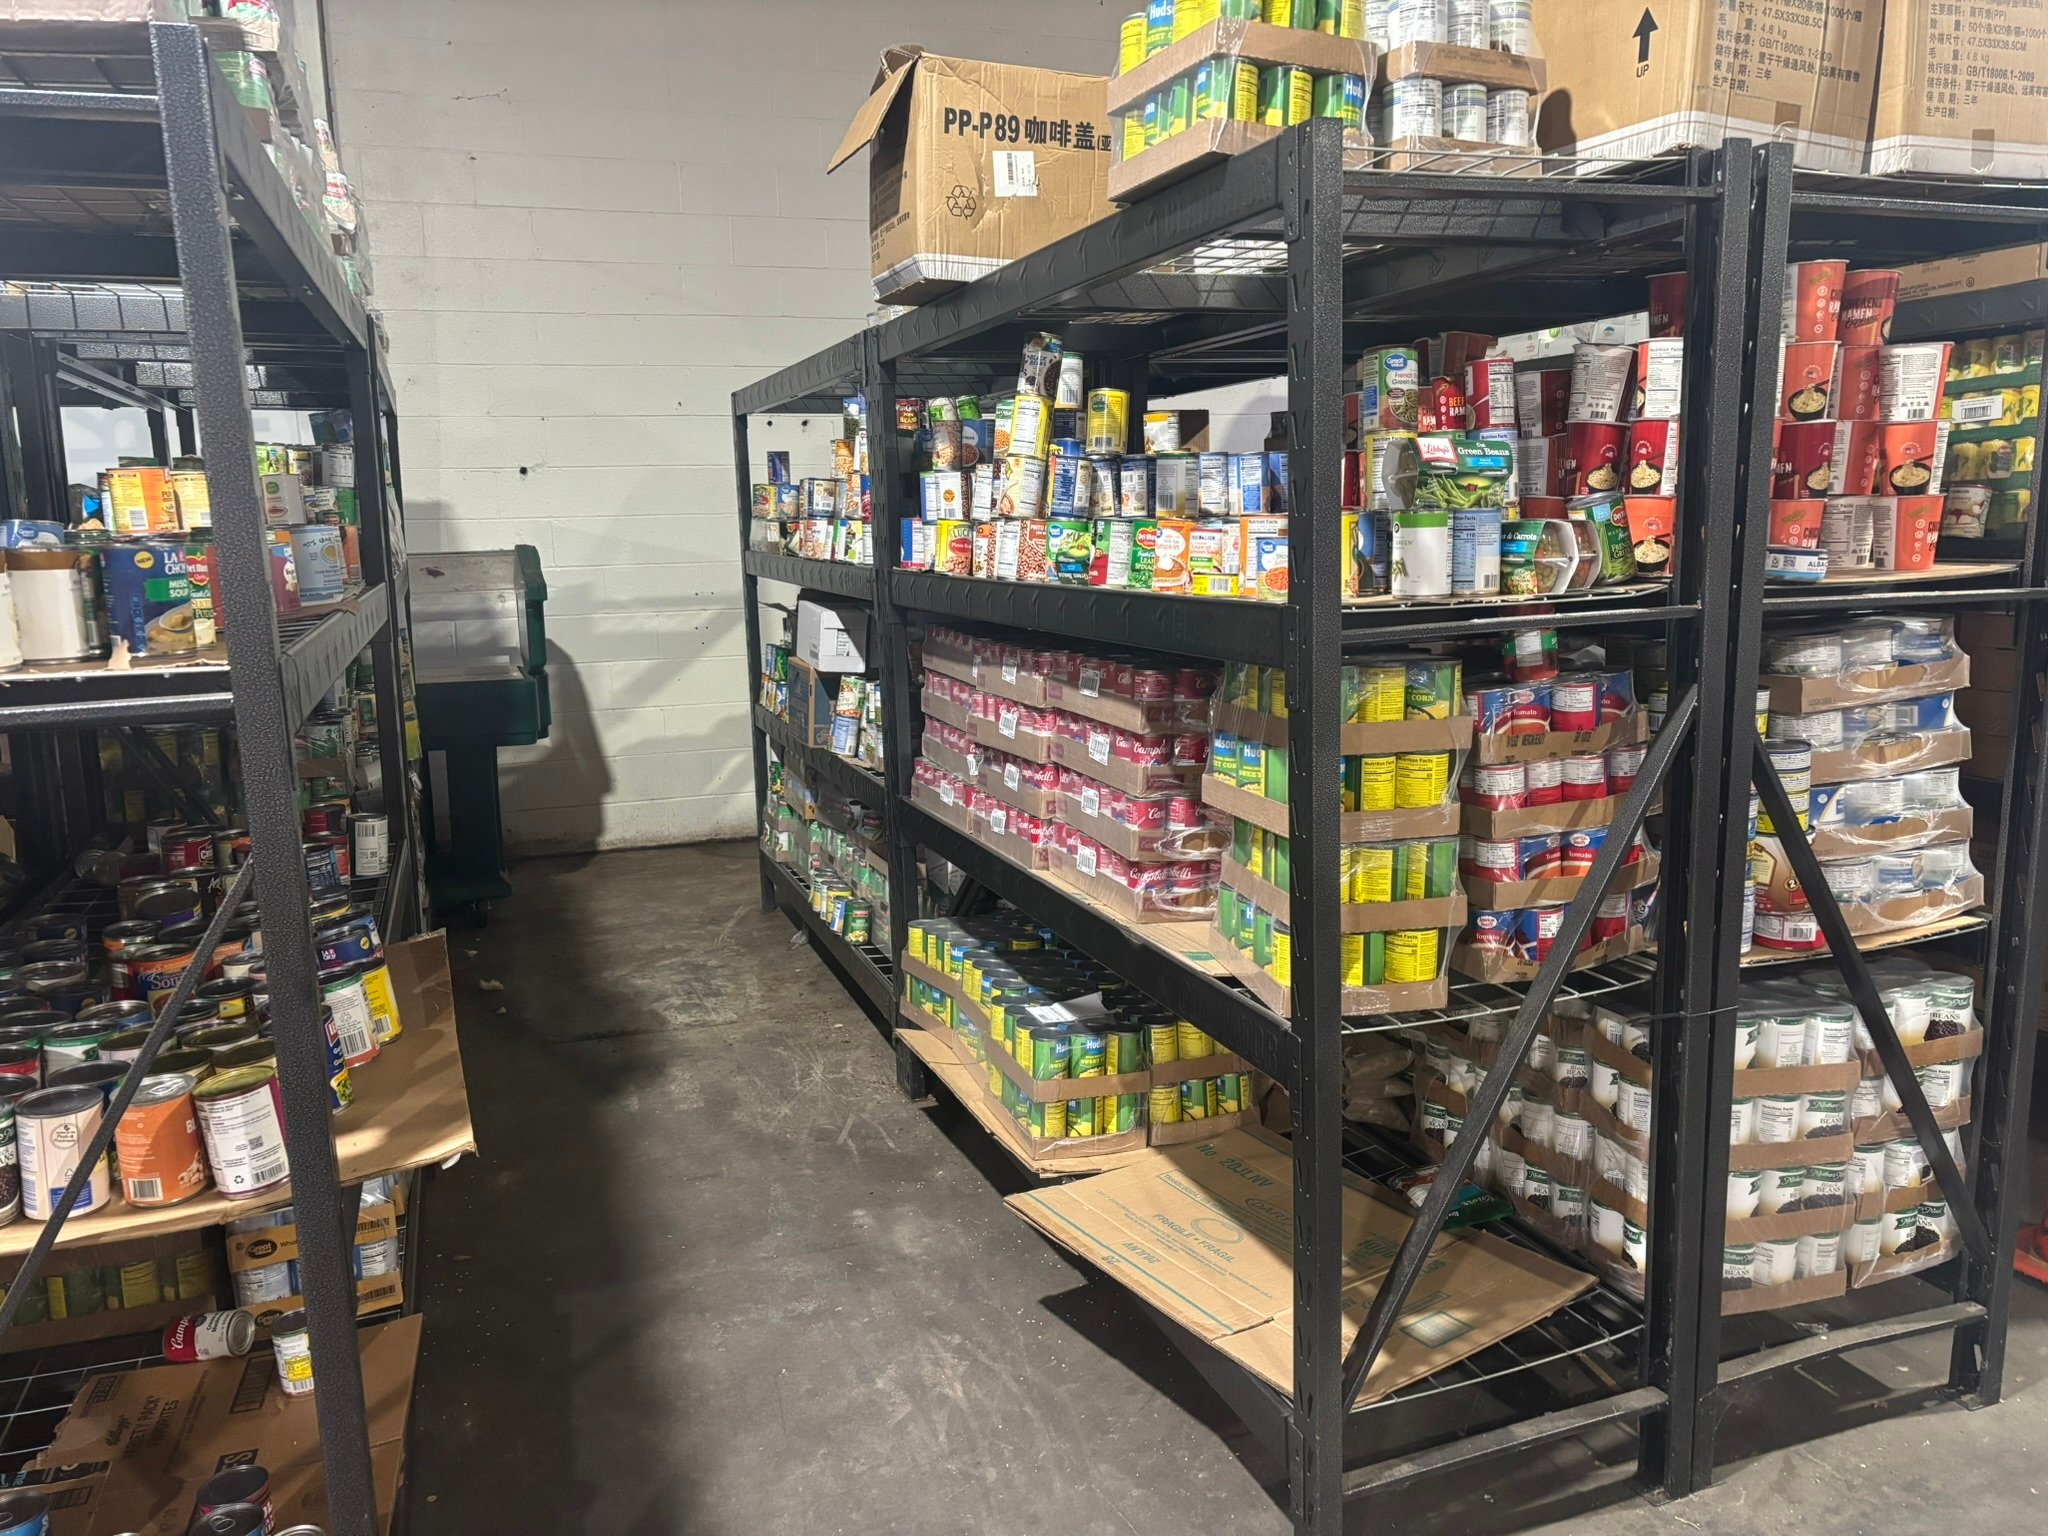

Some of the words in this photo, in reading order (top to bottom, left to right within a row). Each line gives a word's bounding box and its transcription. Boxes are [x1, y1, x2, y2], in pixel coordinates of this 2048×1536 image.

[1777, 25, 1788, 39] kg
[1967, 37, 2027, 51] 47.5X33X38.5CM
[1636, 64, 1650, 78] UP
[1966, 65, 2035, 82] GB/T18006.1-2009
[944, 107, 1021, 143] PP-P89
[1424, 443, 1450, 457] Libby's
[1457, 447, 1482, 456] Green
[1484, 447, 1510, 457] Beans
[1513, 532, 1538, 541] Carrots
[163, 551, 179, 564] LA
[1411, 693, 1434, 702] CORN
[1513, 708, 1537, 716] Tomato
[1568, 851, 1593, 859] Tomato
[1932, 1012, 1961, 1021] BEANS
[1816, 1187, 1841, 1195] BEANS
[1153, 1214, 1195, 1239] FRAGILE
[1198, 1241, 1236, 1263] FRAGIL
